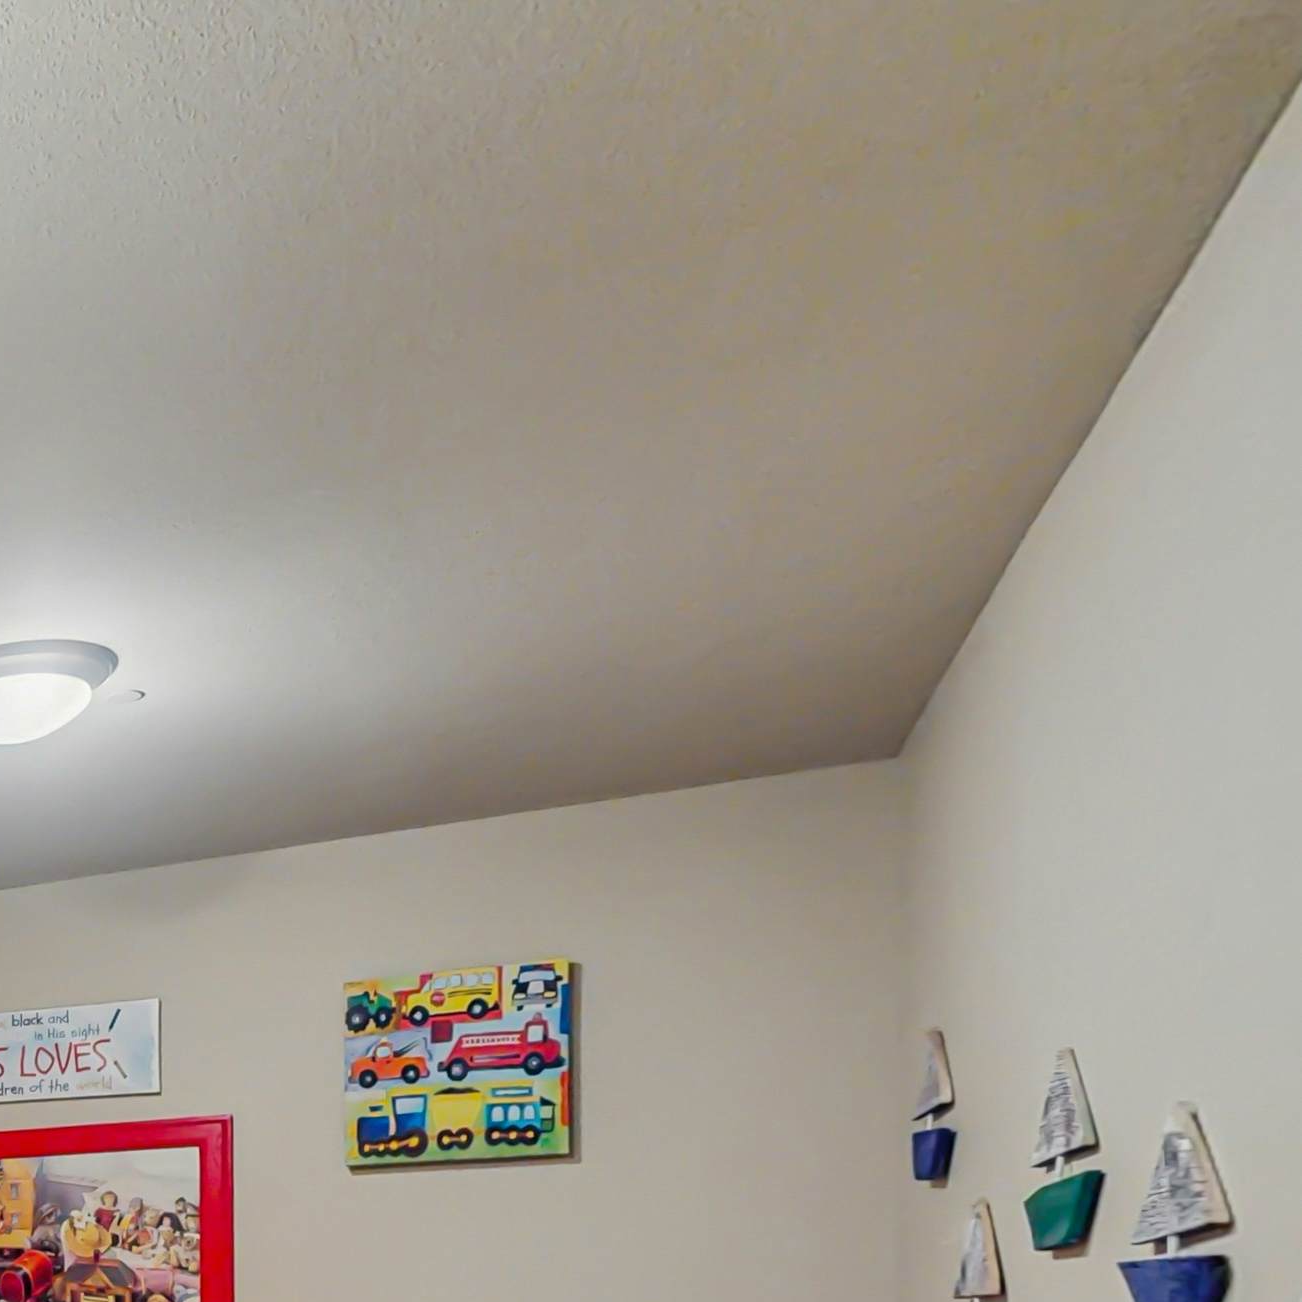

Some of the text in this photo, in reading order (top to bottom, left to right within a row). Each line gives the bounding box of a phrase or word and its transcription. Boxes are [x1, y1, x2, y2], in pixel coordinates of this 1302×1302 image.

[11, 1012, 44, 1028] black
[48, 1010, 69, 1024] and
[70, 1024, 101, 1042] sight
[20, 1038, 111, 1077] LOVES
[29, 1079, 45, 1093] of
[49, 1078, 70, 1093] the
